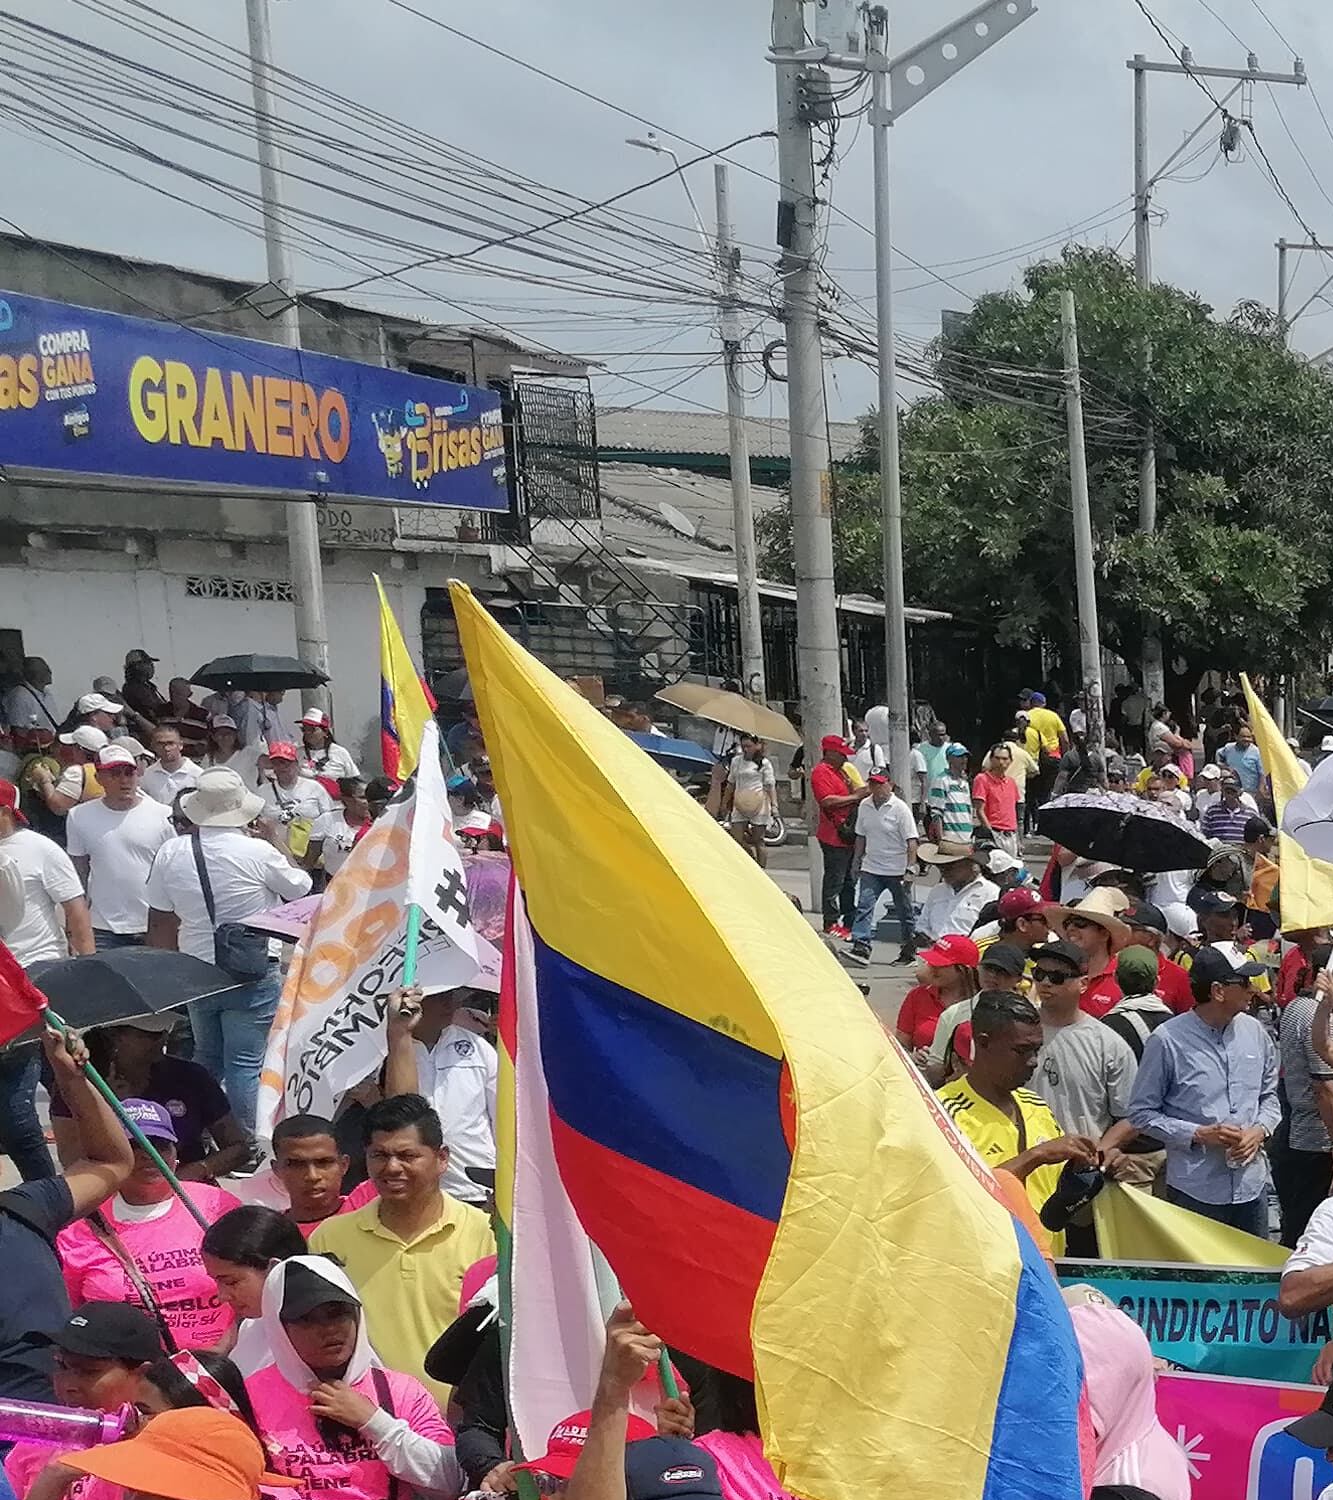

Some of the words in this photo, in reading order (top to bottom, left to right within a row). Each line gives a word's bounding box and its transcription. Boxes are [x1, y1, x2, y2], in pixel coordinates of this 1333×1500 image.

[39, 329, 91, 355] COMPRA
[42, 351, 94, 388] GANA
[129, 355, 350, 463] GRANERO
[406, 403, 482, 482] Brisas
[1118, 1291, 1275, 1345] SINDICATO
